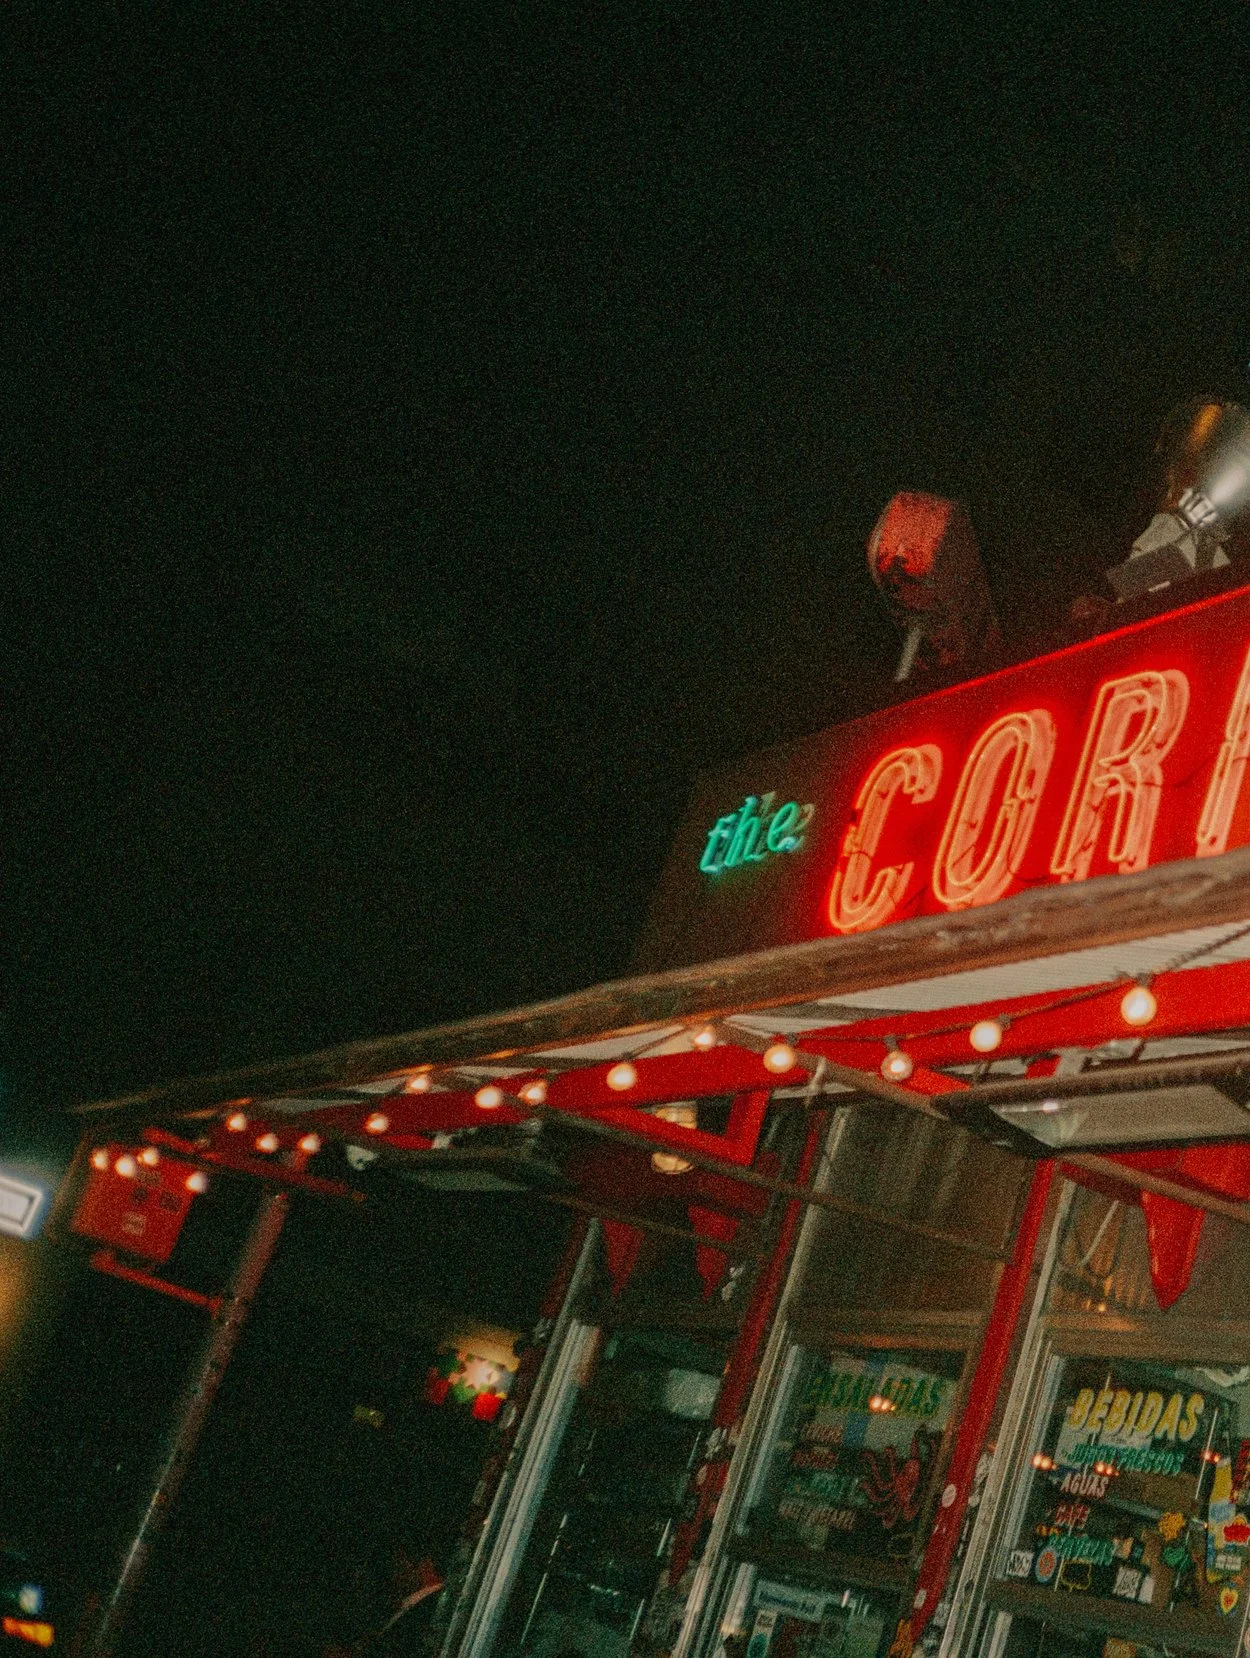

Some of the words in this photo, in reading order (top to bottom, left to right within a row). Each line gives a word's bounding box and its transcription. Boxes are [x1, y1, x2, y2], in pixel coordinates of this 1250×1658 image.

[699, 791, 815, 873] the
[1067, 1388, 1204, 1442] BEBIDAS
[1060, 1472, 1109, 1498] AGUAS
